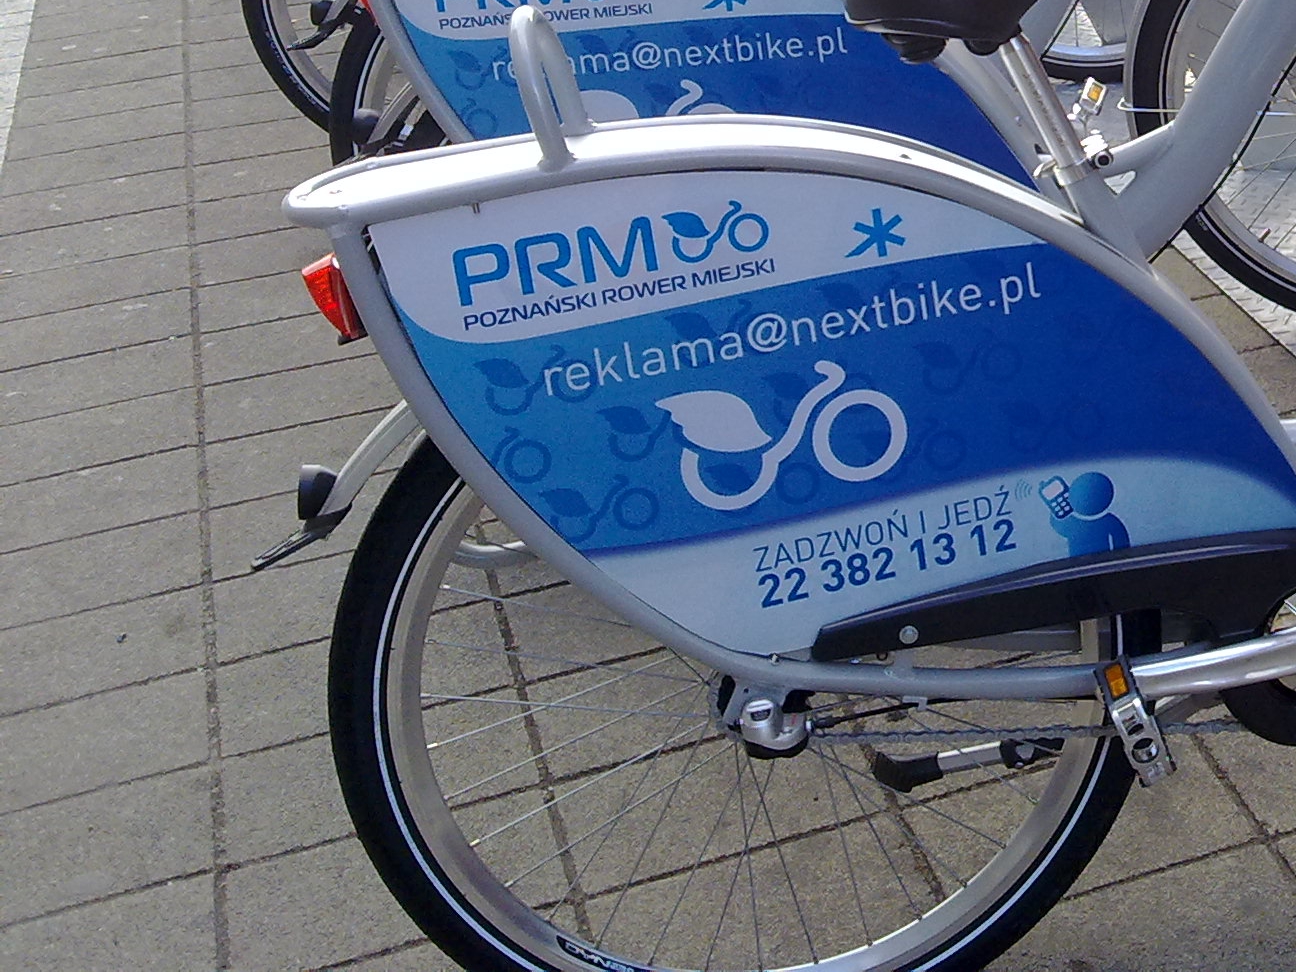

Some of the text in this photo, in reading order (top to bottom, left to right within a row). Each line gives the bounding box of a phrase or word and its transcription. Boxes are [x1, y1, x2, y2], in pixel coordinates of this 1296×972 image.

[438, 2, 653, 29] POZNAŃS OWER MIEJSKI
[492, 26, 848, 82] rma@nextbike.pl
[452, 215, 659, 307] PRM
[462, 257, 776, 331] POZNAŃSKI ROWER MIEJSKI
[543, 261, 1041, 397] reklama@nextbike.pl
[752, 485, 1013, 573] ZADZWOŃ I JEDŹ
[758, 519, 1018, 609] 22 382 13 12
